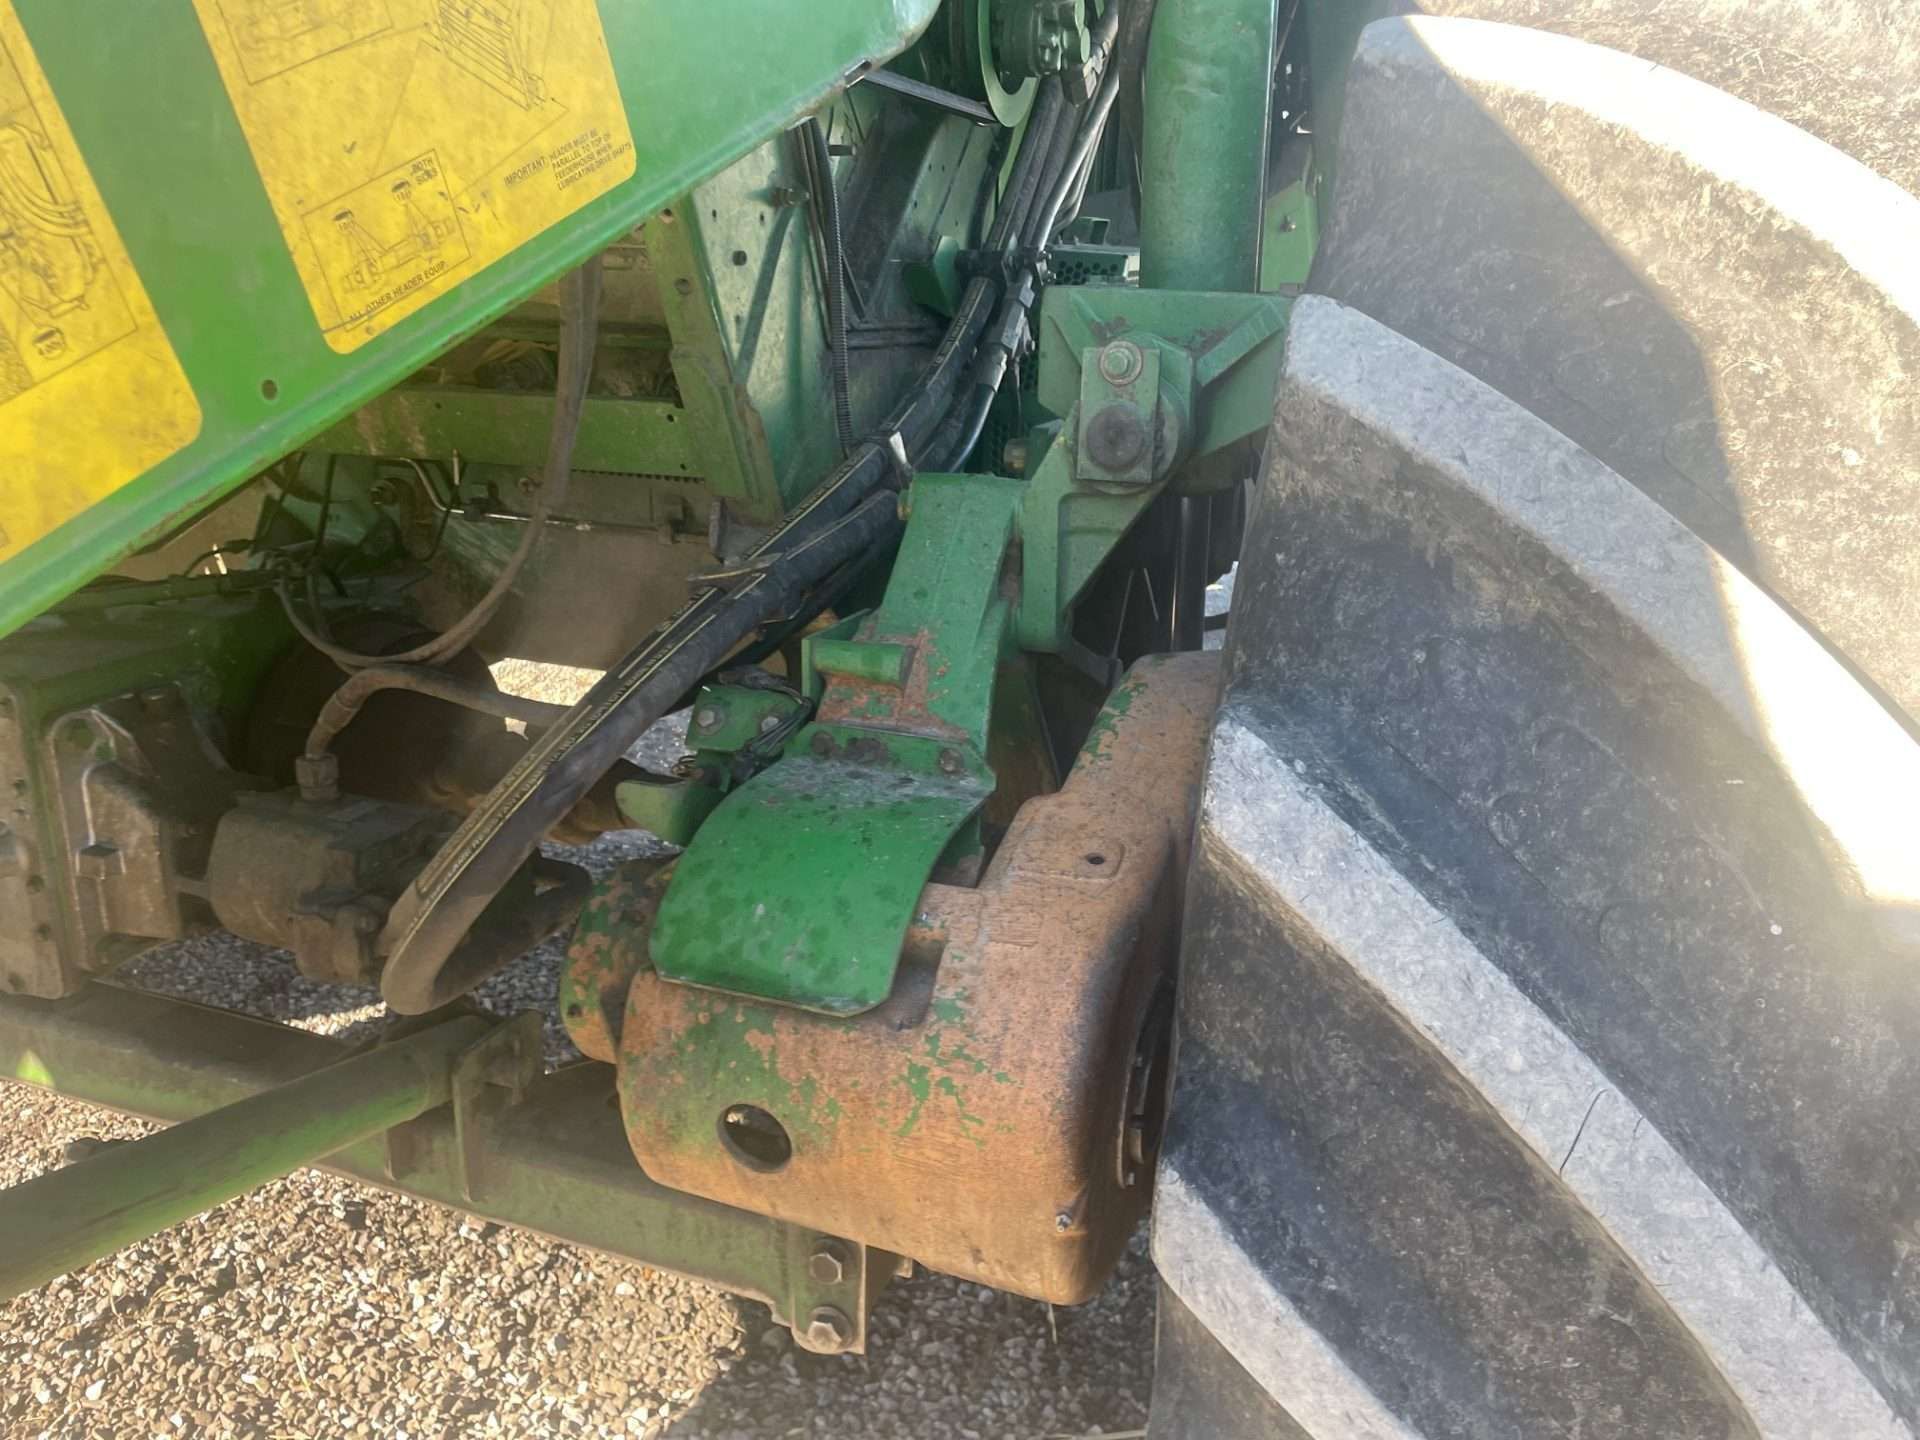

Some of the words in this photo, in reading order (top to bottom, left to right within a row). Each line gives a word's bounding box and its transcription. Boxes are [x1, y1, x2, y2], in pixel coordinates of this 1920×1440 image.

[504, 155, 545, 185] IMPORTANT
[552, 150, 582, 172] PARALLEL
[393, 274, 424, 297] HEADER
